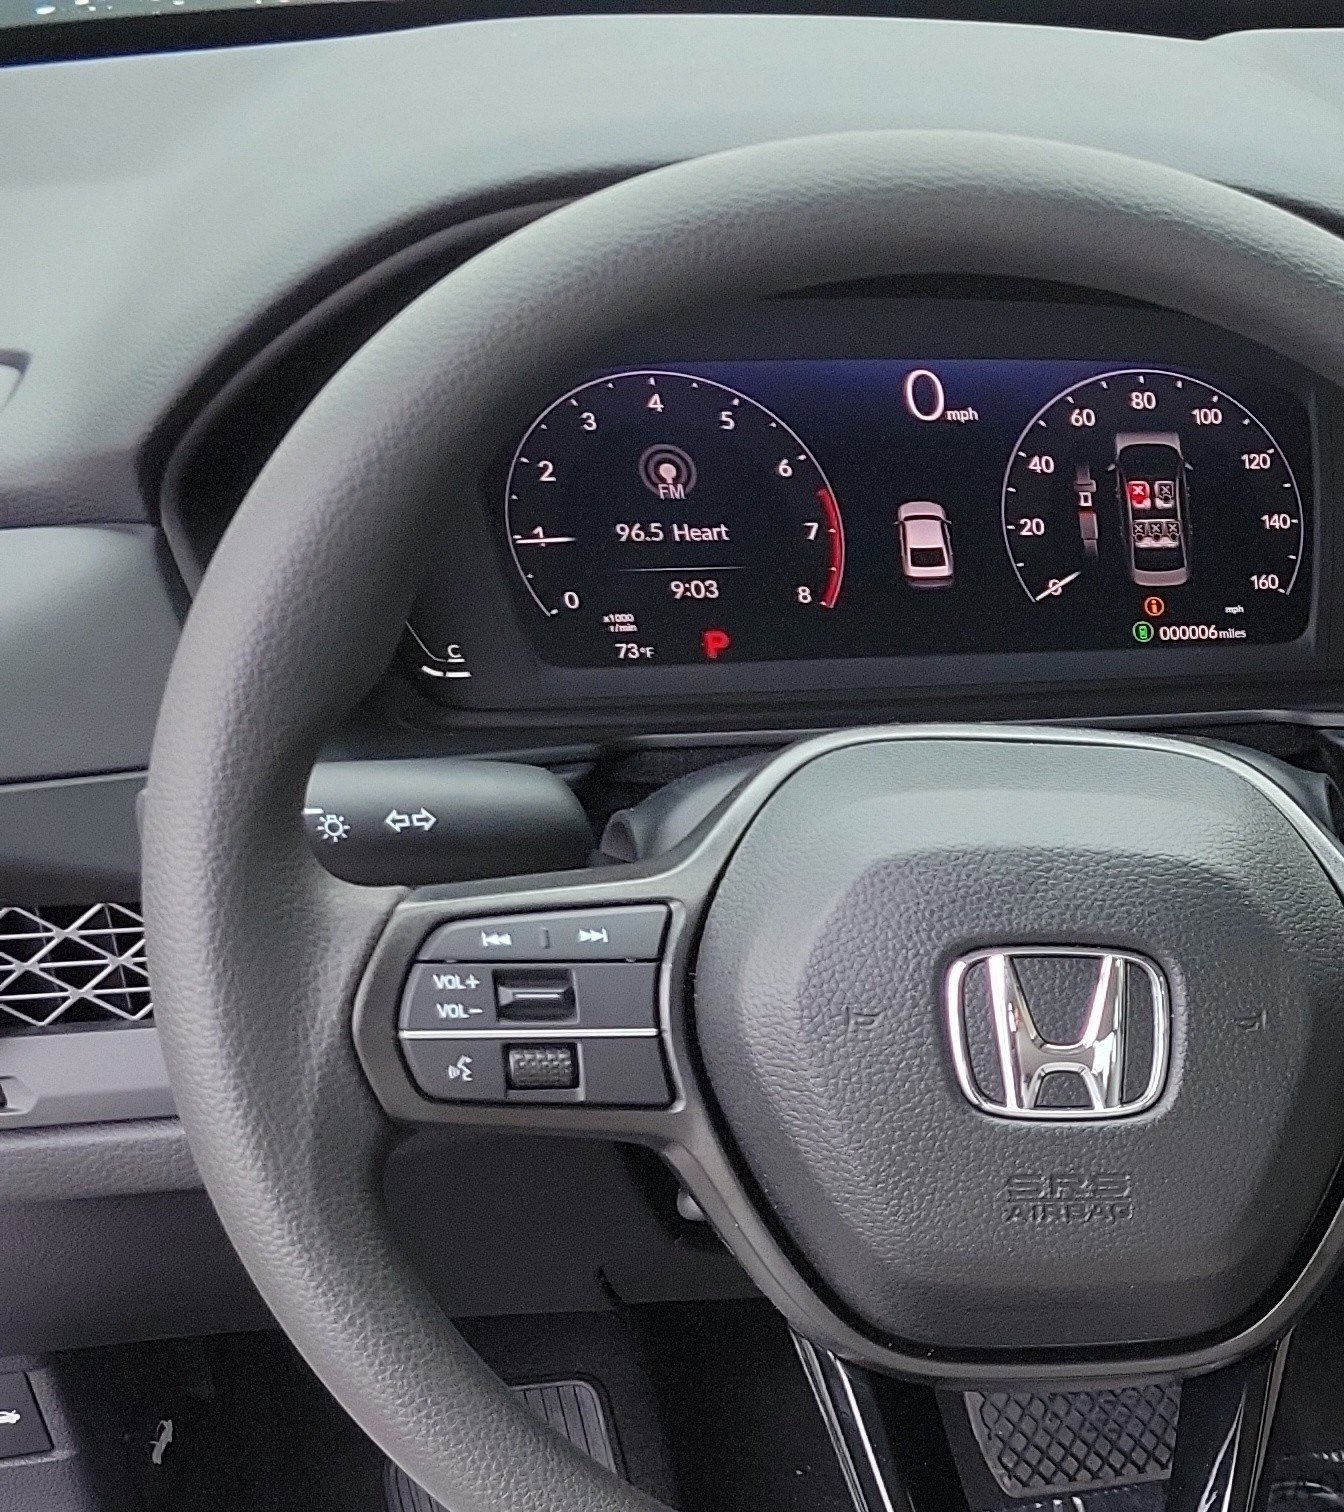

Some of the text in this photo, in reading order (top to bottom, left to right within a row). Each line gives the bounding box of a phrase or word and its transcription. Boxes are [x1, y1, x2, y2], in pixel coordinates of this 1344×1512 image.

[647, 394, 664, 412] 4
[906, 370, 979, 424] 0 mph
[1131, 392, 1156, 410] 80
[581, 412, 597, 431] 3
[720, 412, 735, 430] 5
[1071, 408, 1096, 428] 60
[1192, 408, 1222, 425] 100
[778, 459, 793, 477] 6
[1029, 455, 1055, 474] 40
[1241, 453, 1270, 470] 120
[538, 461, 556, 482] 2
[1020, 518, 1045, 537] 20
[1261, 513, 1290, 530] 140
[615, 523, 730, 543] 96.5 Heart
[804, 522, 819, 541] 7
[670, 580, 719, 600] 9:03
[1250, 574, 1279, 591] 160
[564, 592, 580, 609] 0
[797, 586, 812, 604] 8
[1159, 625, 1246, 640] 000006 miles
[448, 645, 461, 658] C
[703, 628, 730, 657] P
[433, 974, 480, 989] VOL+
